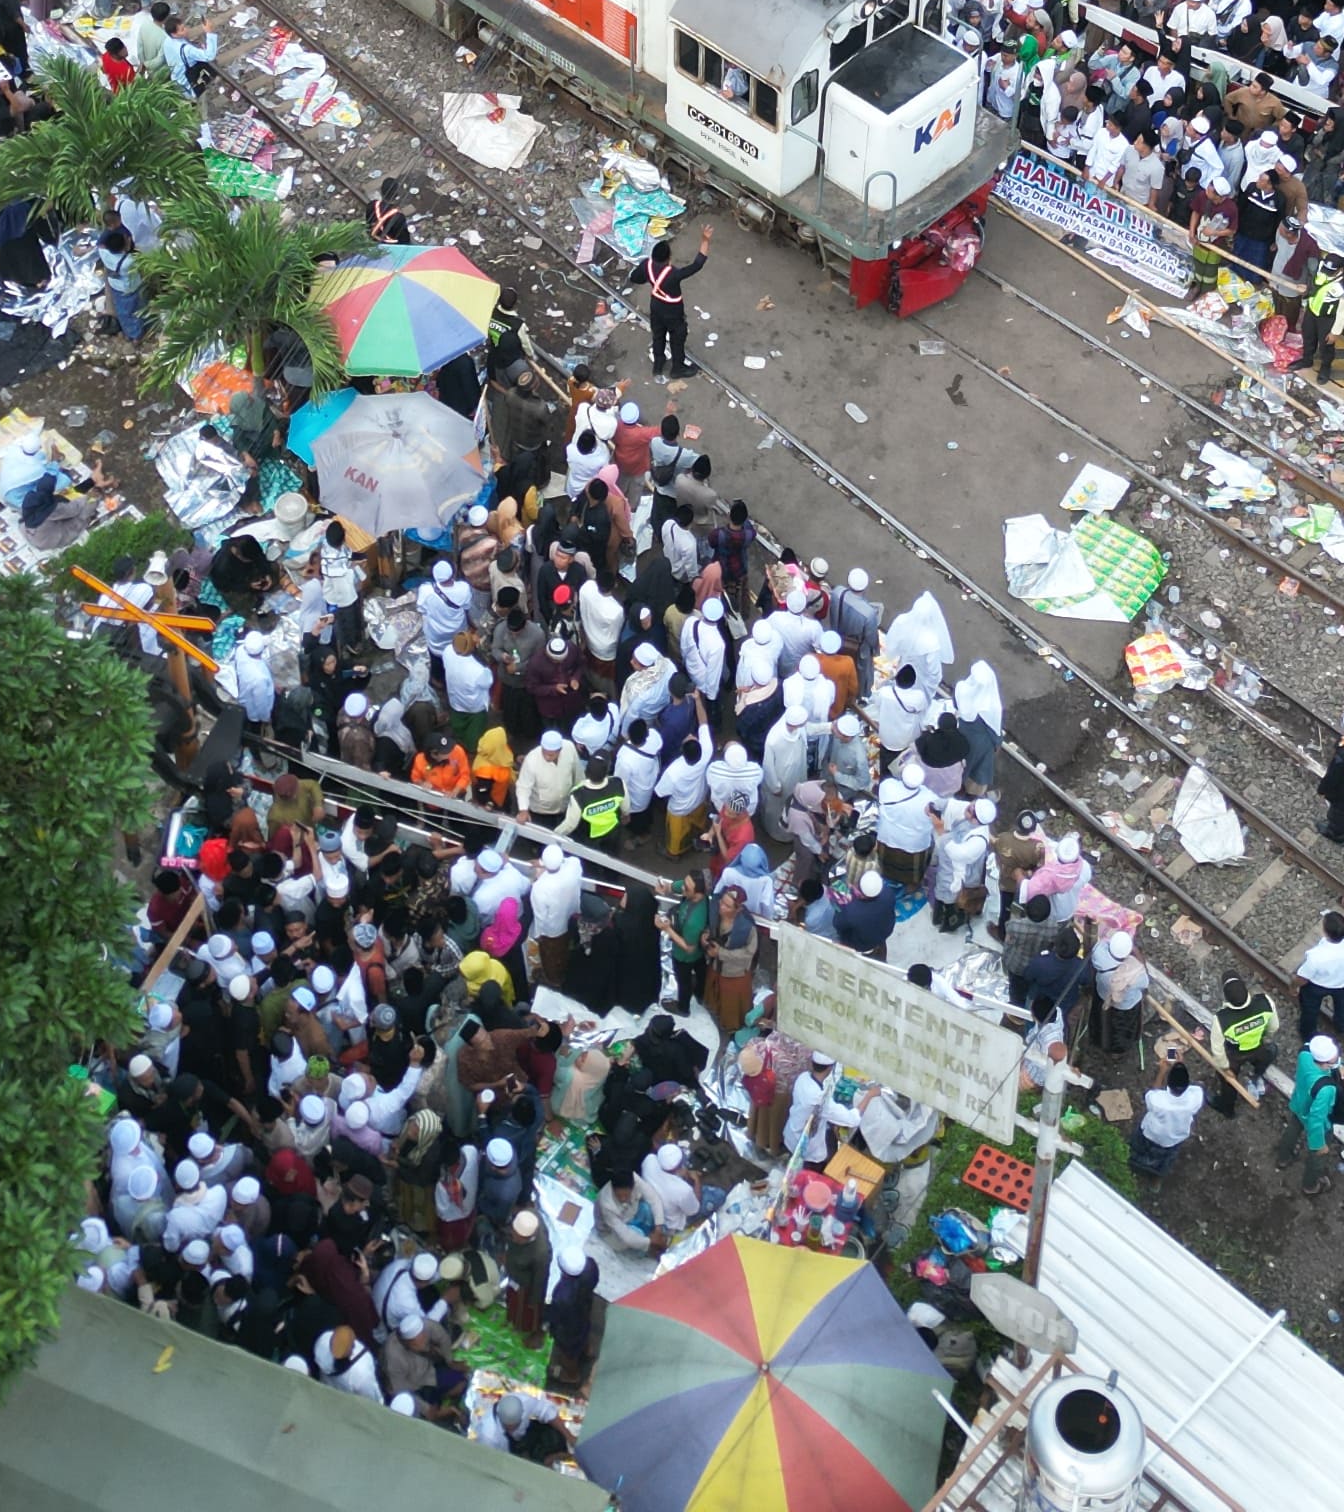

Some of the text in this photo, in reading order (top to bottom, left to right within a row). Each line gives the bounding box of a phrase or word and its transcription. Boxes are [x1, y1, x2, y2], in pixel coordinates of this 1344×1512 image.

[913, 99, 962, 154] KAI
[1012, 155, 1069, 197] HATI
[1071, 188, 1126, 224] HATI
[1073, 223, 1107, 244] AMAN
[1108, 237, 1139, 257] BARU
[1140, 251, 1177, 276] JALAN
[1117, 225, 1159, 253] KERETA
[815, 957, 986, 1056] BERHENTI
[862, 1016, 899, 1044] KIRI
[903, 1032, 939, 1061] DAN
[942, 1052, 1005, 1094] KANAN
[964, 1094, 998, 1121] REL
[980, 1284, 1070, 1344] STOP
